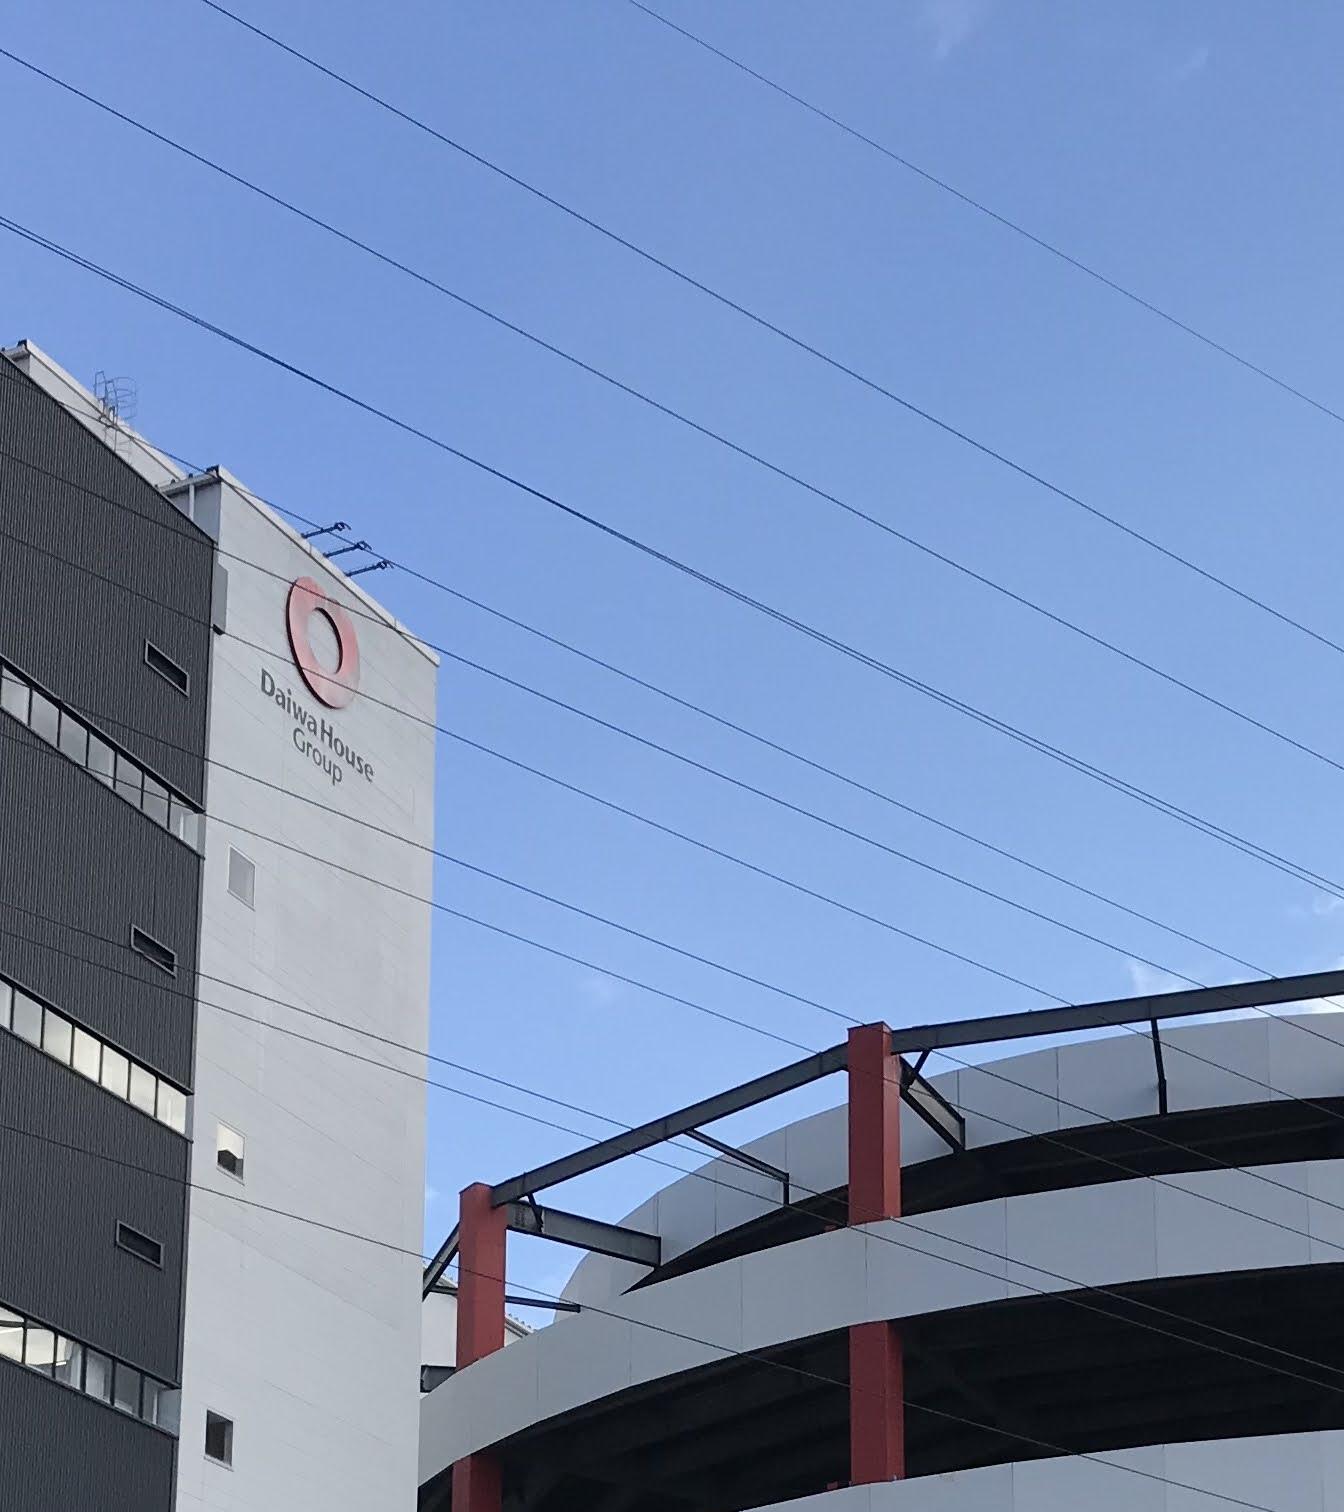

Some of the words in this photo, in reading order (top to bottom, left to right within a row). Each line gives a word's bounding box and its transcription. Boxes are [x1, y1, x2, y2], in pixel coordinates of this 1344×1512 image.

[260, 667, 317, 734] Daiwa
[320, 719, 375, 783] House
[292, 727, 343, 786] Group
